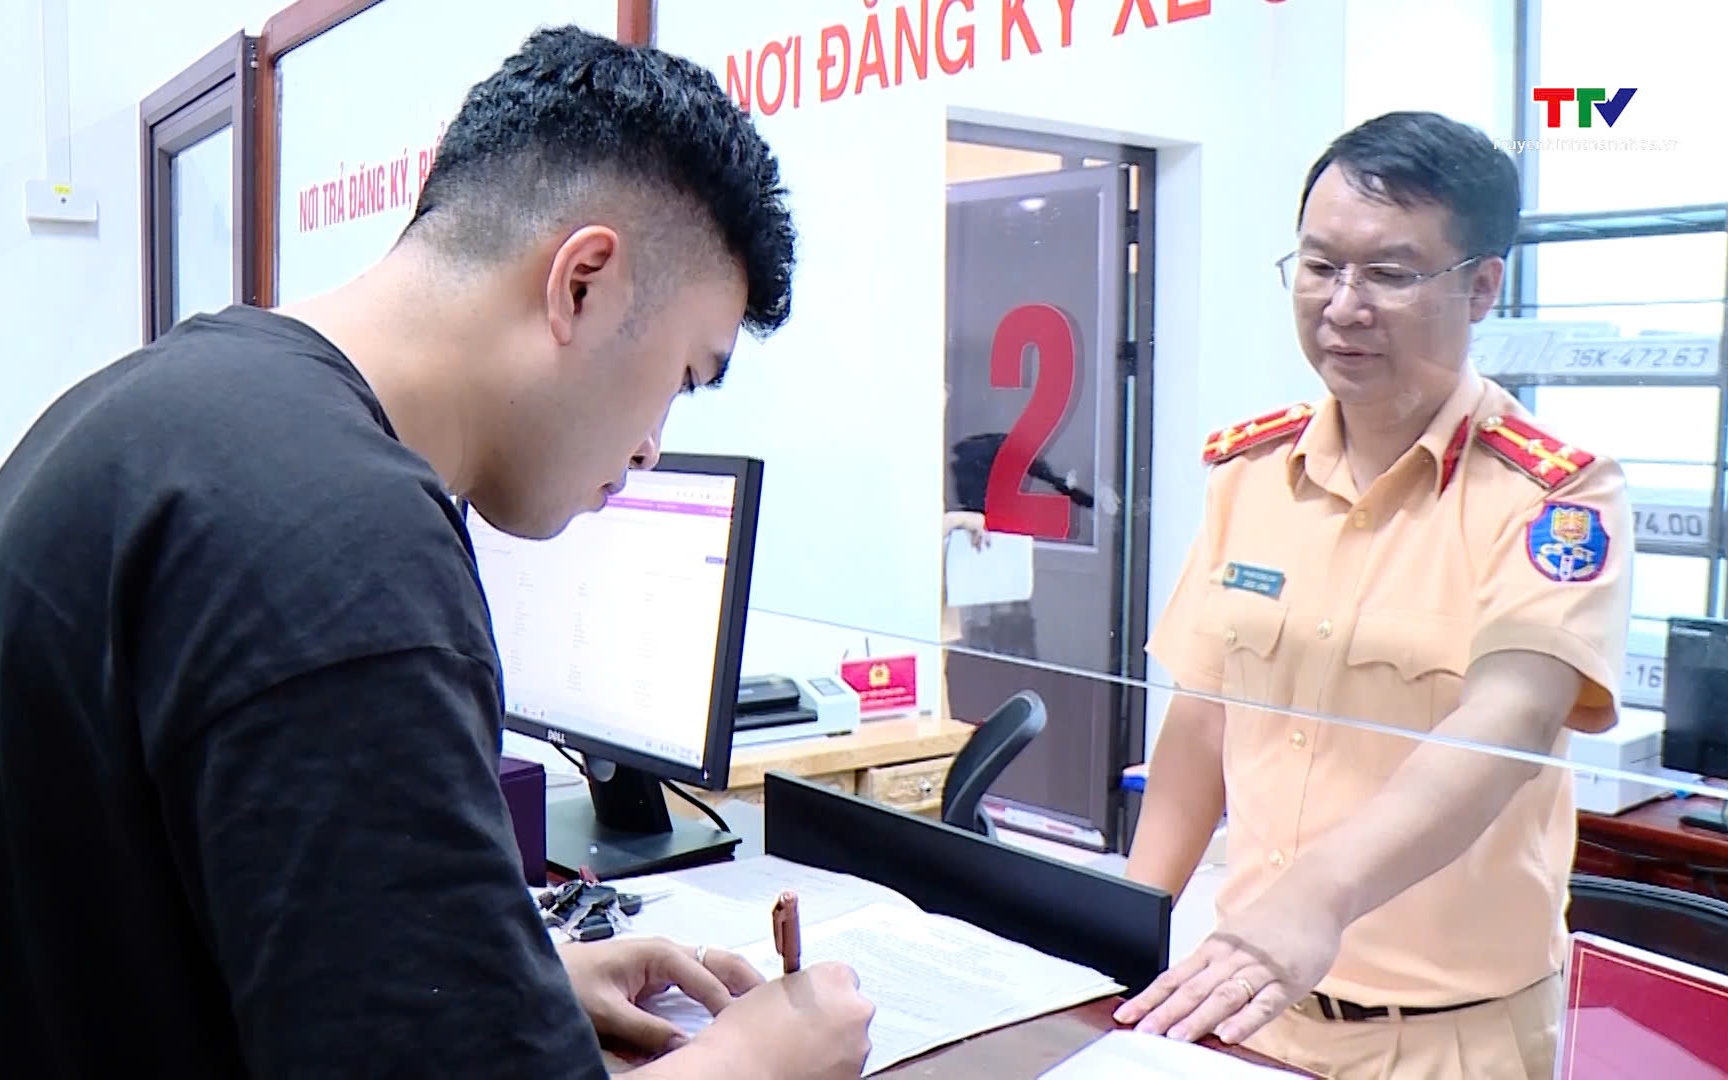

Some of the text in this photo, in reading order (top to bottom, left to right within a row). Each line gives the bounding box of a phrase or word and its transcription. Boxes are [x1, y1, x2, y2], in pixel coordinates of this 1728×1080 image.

[726, 35, 801, 117] NƠI
[817, 0, 975, 102] ĐĂNG
[299, 184, 318, 232] NƠI
[323, 161, 345, 226] TRẢ
[349, 161, 385, 220] ĐĂNG
[985, 303, 1075, 540] 2
